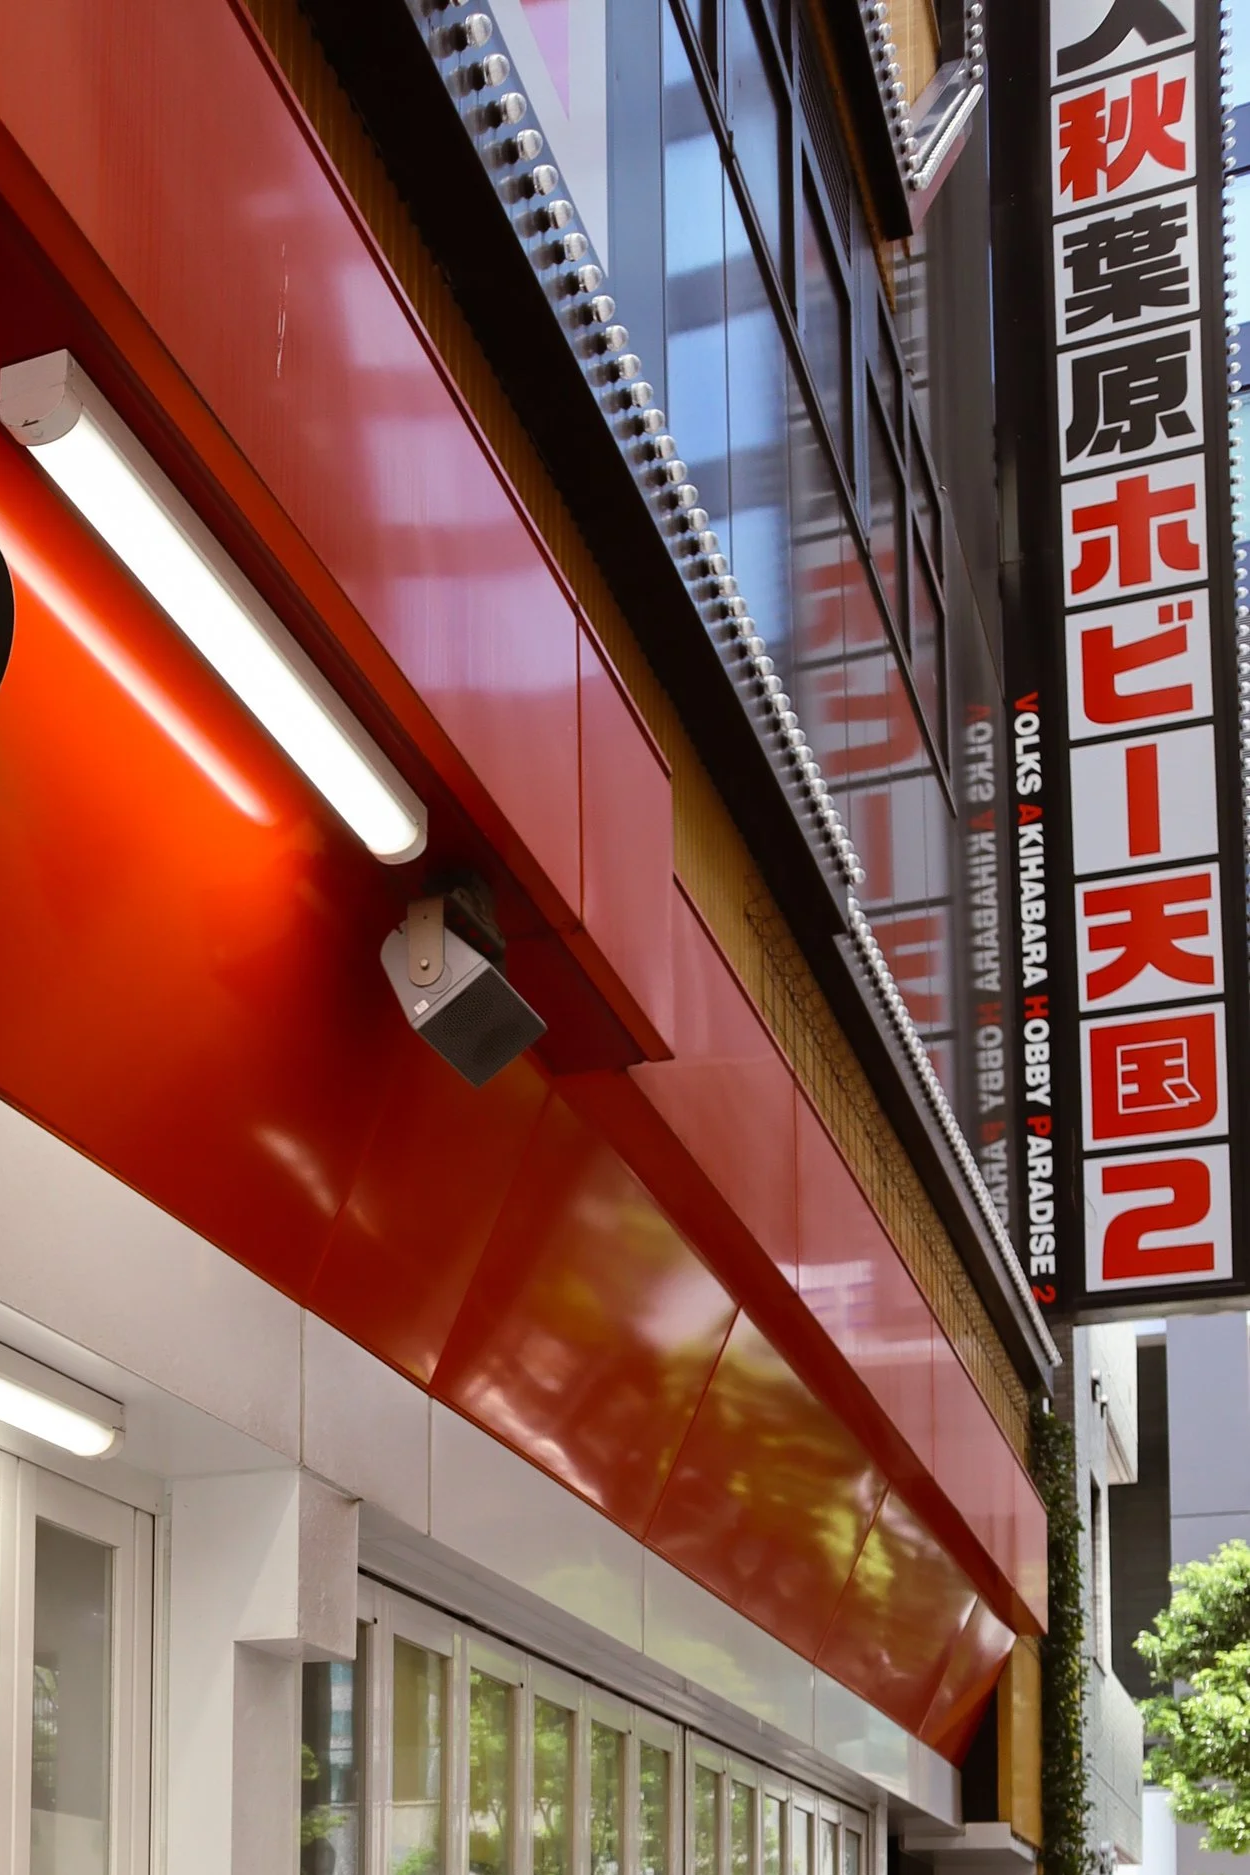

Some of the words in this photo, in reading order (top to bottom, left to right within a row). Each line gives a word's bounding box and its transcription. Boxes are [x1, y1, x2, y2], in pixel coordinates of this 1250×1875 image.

[1014, 691, 1043, 796] VOLKS
[1017, 803, 1050, 989] AKIHABARA
[1023, 994, 1053, 1107] HOBBY
[1026, 1115, 1057, 1276] PARADISE
